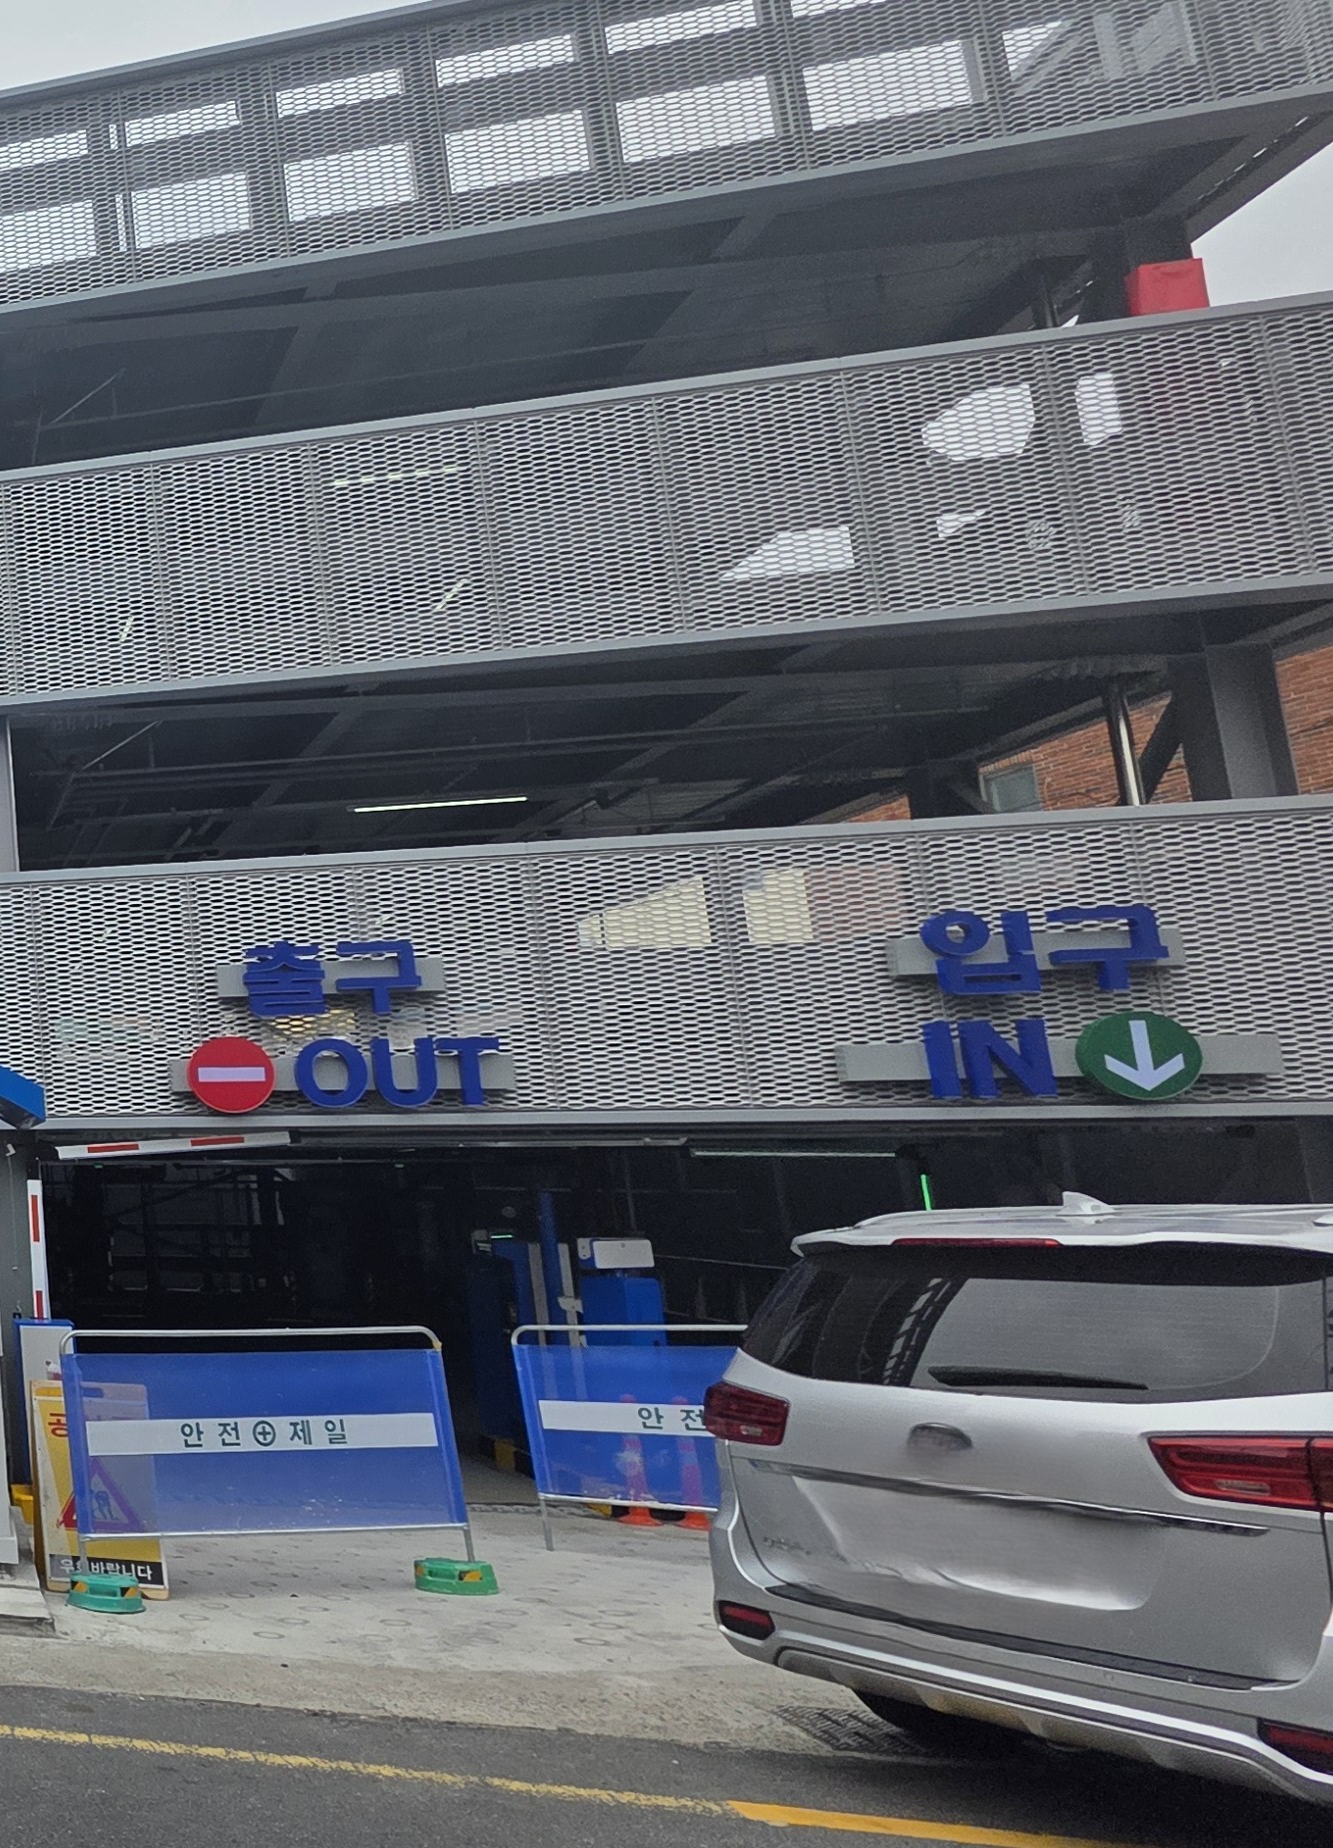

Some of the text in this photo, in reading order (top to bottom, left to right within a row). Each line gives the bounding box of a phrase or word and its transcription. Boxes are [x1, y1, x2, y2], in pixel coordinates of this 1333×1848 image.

[242, 939, 422, 1019] 출구
[919, 903, 1170, 996] 입구
[294, 1034, 500, 1108] OUT
[921, 1018, 1059, 1099] IN
